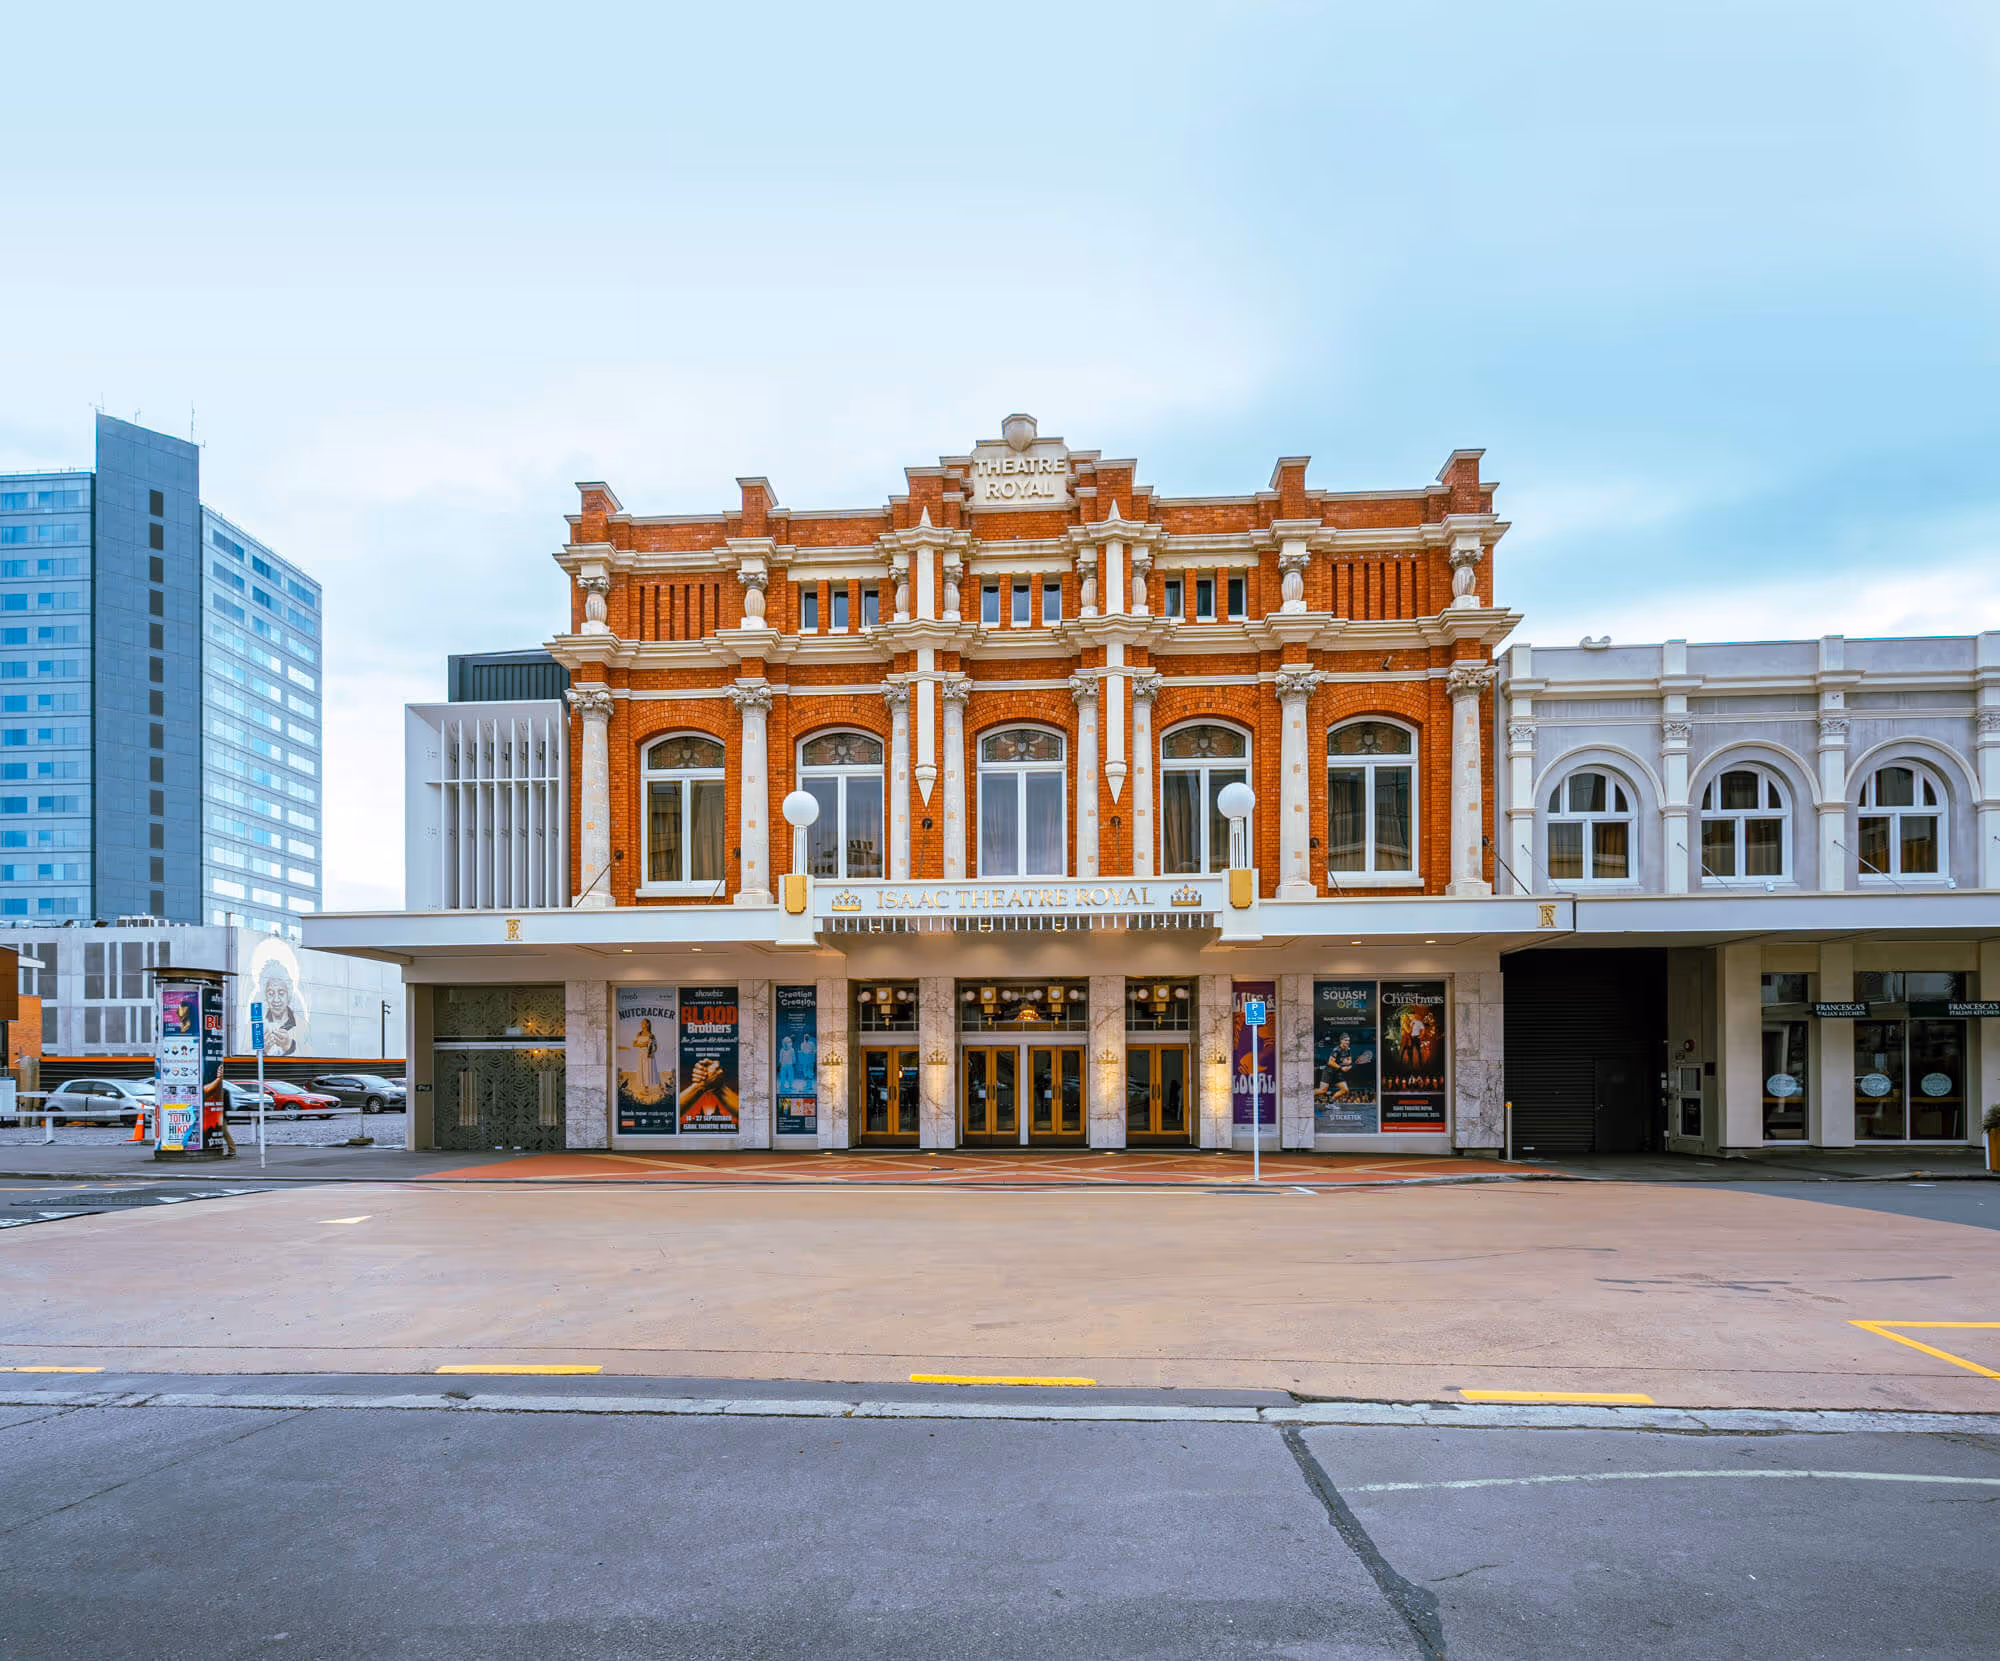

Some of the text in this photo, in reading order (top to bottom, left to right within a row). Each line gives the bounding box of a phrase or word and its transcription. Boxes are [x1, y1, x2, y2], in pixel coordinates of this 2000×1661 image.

[975, 457, 1066, 477] THEATRE
[985, 480, 1055, 499] ROYAL
[876, 887, 1156, 909] ISAAC THEATRE ROYAL
[694, 988, 724, 998] showbiz
[1322, 990, 1367, 1001] SQUASH
[1382, 992, 1444, 1005] Christmas
[781, 999, 816, 1007] Creation
[1336, 1000, 1367, 1008] OPEN
[1816, 1003, 1866, 1011] FRANCESCA'S
[618, 1007, 676, 1020] NUTCRACKER
[680, 1006, 738, 1025] BLOOD
[687, 1022, 732, 1034] Brothers
[1232, 1073, 1276, 1094] LOCAL
